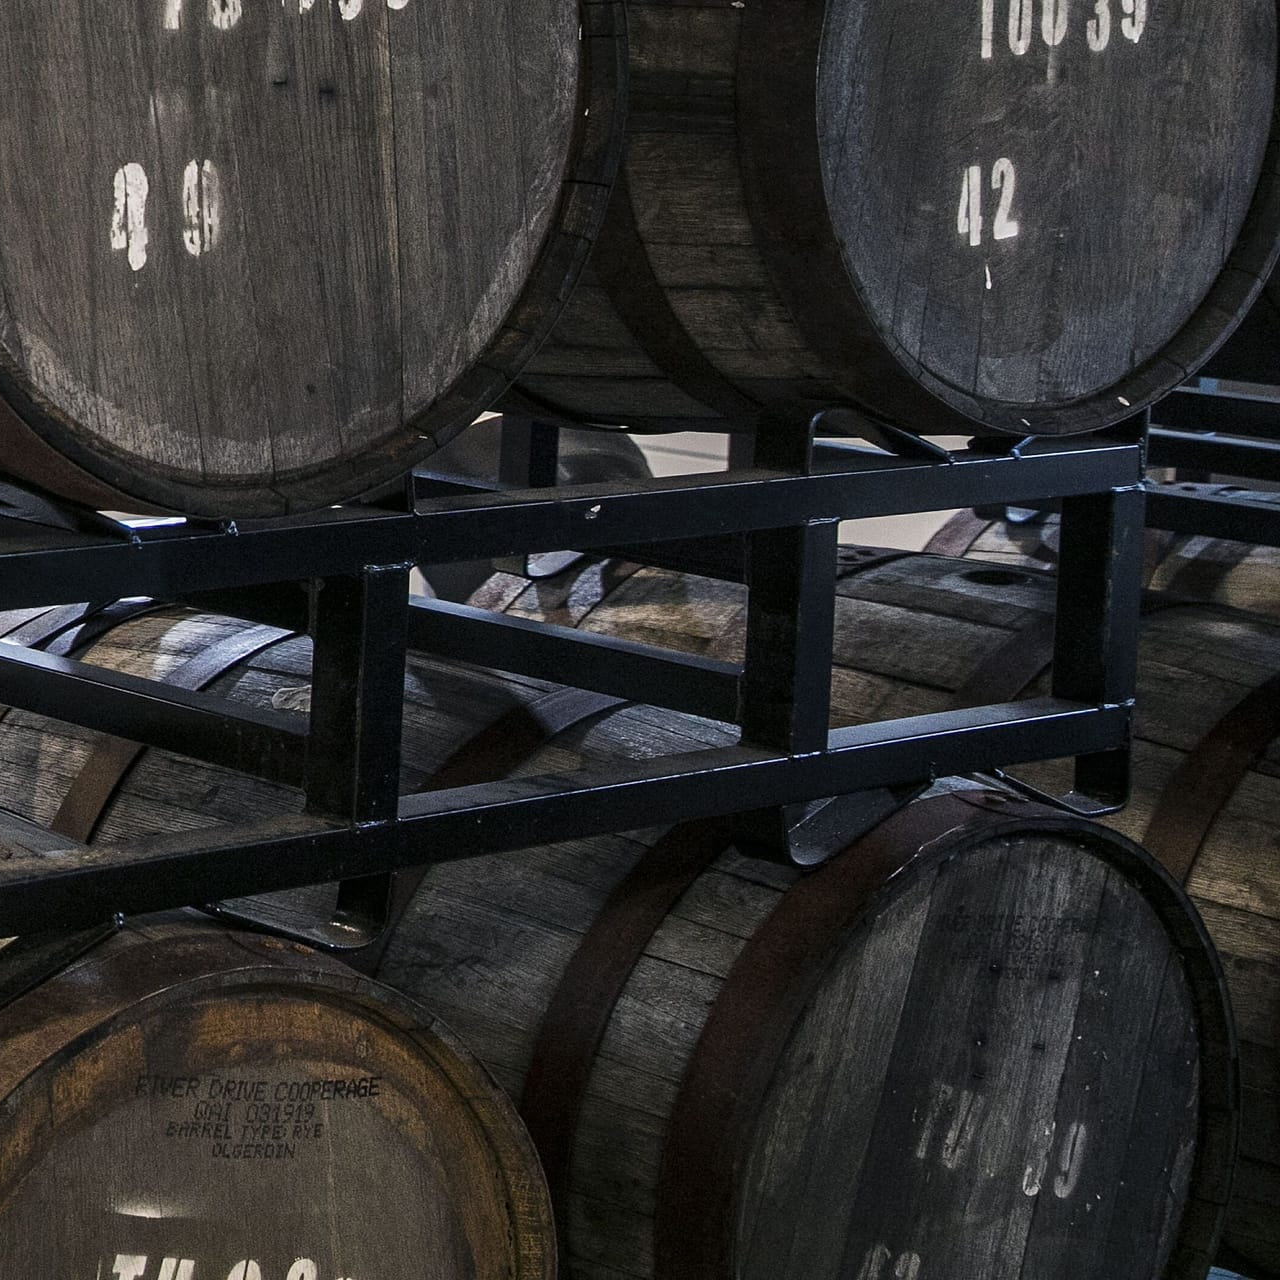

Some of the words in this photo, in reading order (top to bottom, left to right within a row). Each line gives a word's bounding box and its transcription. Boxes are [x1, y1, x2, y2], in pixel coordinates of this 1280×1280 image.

[956, 156, 1020, 248] 42
[208, 1078, 269, 1103] DRIVE
[274, 1075, 383, 1103] COOPERAGE
[292, 1122, 324, 1140] RYE
